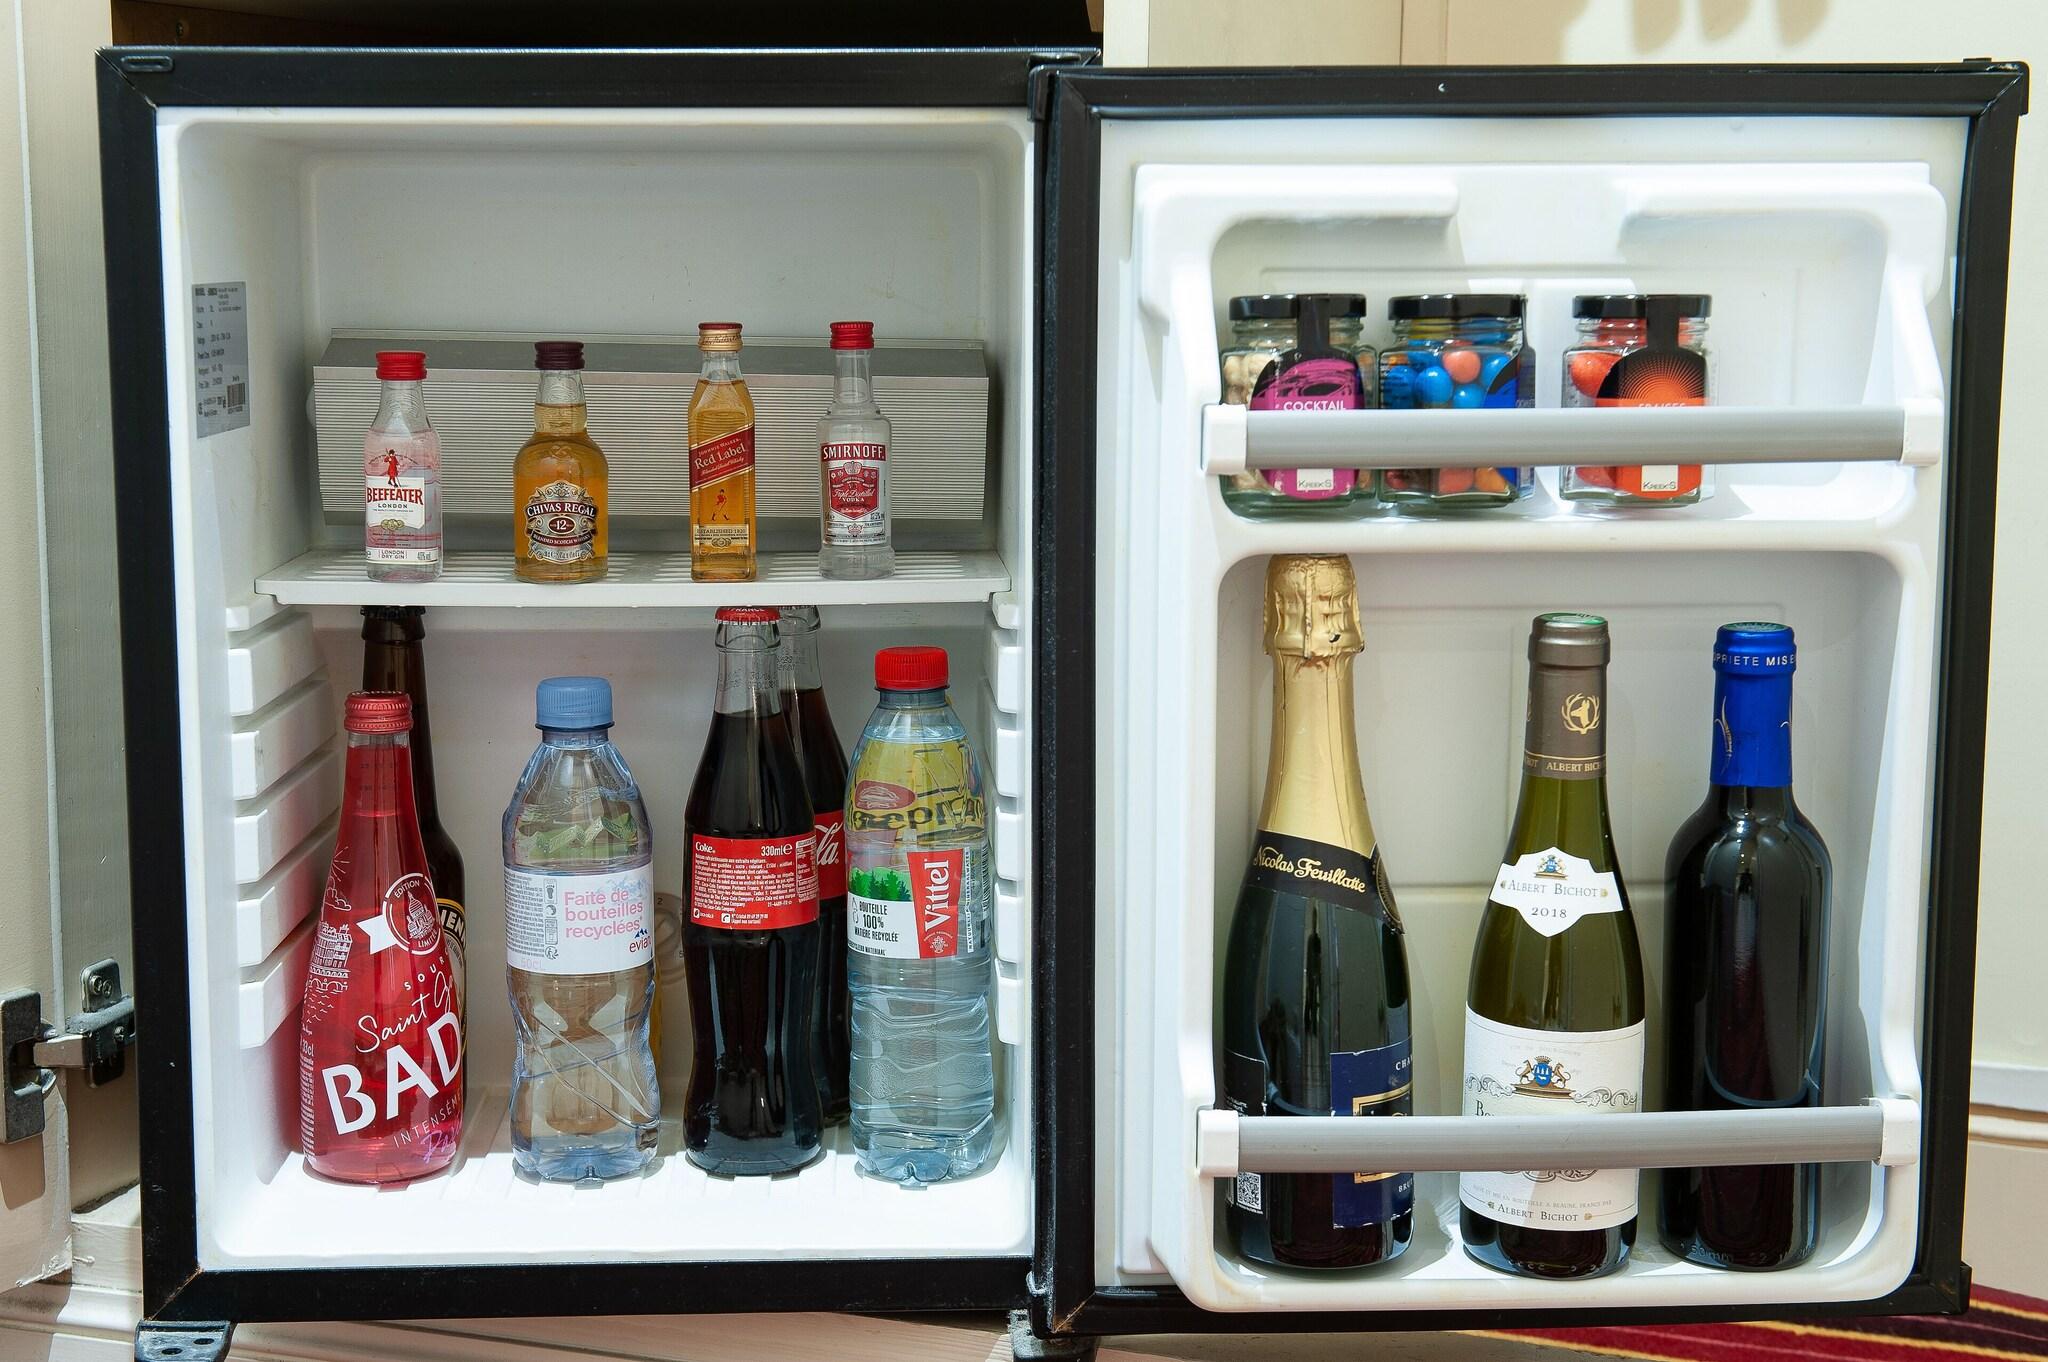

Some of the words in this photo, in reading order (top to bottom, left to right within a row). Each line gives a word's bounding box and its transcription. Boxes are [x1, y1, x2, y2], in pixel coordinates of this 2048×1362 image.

[1283, 400, 1345, 410] COCKTAIL
[694, 454, 715, 470] Red
[717, 443, 746, 460] Label
[823, 445, 882, 460] SMIRNOFF
[367, 487, 423, 505] BEEFEATER
[527, 502, 562, 517] CHIVAS
[564, 502, 595, 517] REGAL
[555, 520, 567, 530] 12
[1546, 761, 1583, 772] ALBERT
[695, 841, 713, 853] Coke
[1253, 845, 1294, 873] Nicolas
[1294, 858, 1366, 893] Feuillatte
[924, 858, 950, 933] Vittel
[1508, 880, 1547, 894] ALBERT
[1554, 883, 1598, 897] BICHOT
[564, 891, 606, 906] Faite
[611, 888, 629, 902] de
[566, 902, 643, 921] bouteilles
[859, 901, 888, 915] BOUTEILLE
[1531, 907, 1567, 918] 2018
[863, 914, 884, 930] 100%
[356, 993, 430, 1053] Saint
[1498, 1204, 1534, 1218] ALBERT
[1540, 1211, 1578, 1222] BICHOT
